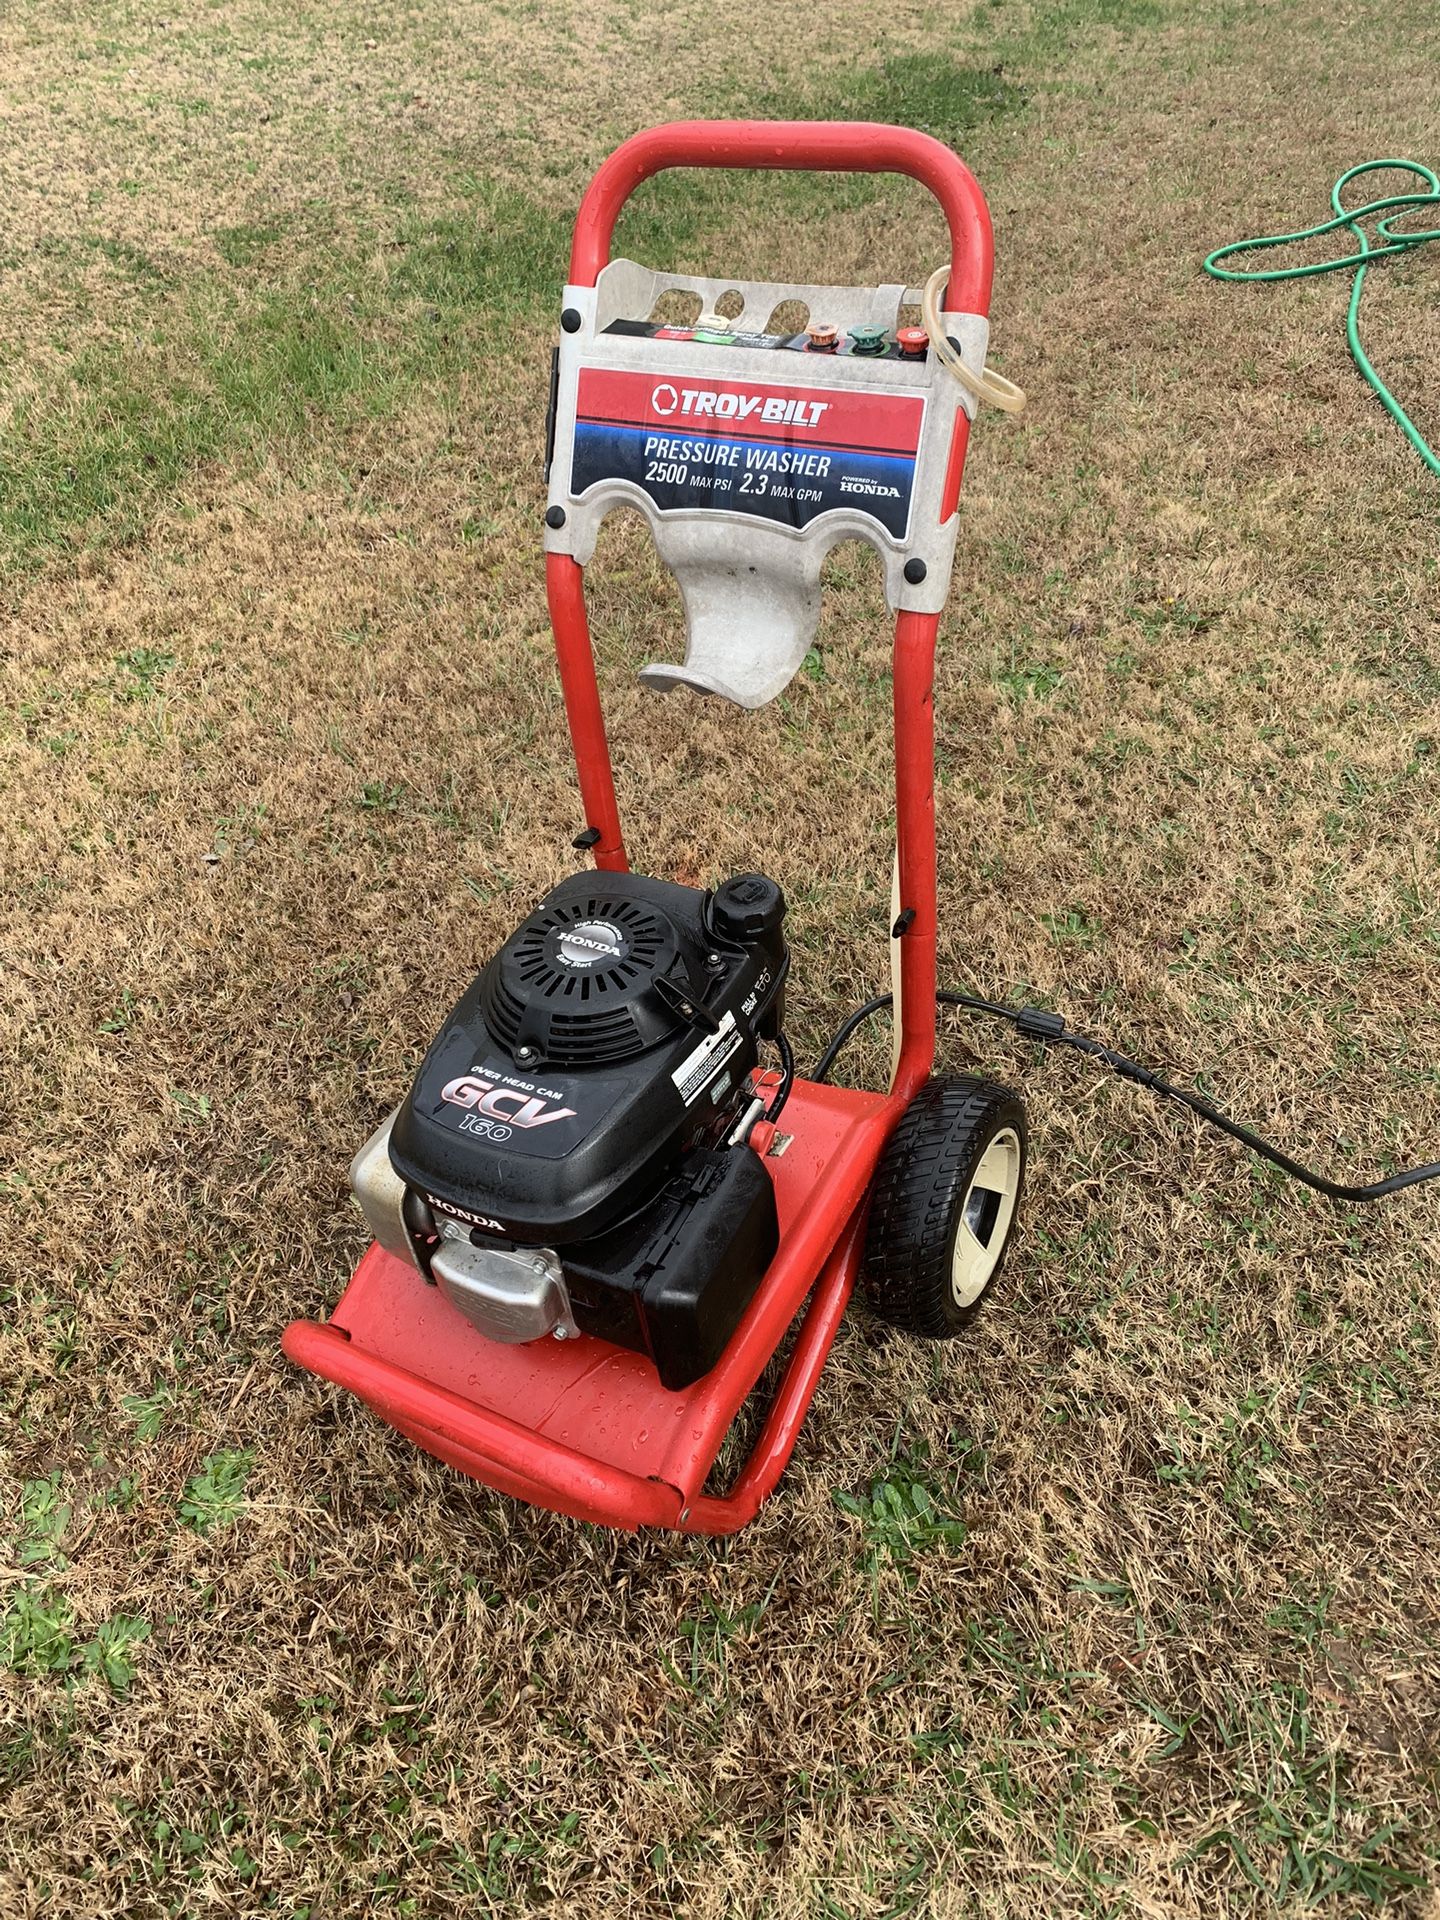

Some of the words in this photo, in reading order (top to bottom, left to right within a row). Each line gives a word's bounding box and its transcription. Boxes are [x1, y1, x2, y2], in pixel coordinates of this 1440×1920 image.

[680, 389, 828, 427] TROY-BILT
[643, 436, 742, 467] PRESSURE
[746, 448, 831, 477] WASHER
[644, 461, 688, 485] 2500
[689, 475, 712, 489] MAX
[713, 479, 733, 491] PSI
[739, 472, 769, 495] 2.3
[770, 485, 795, 499] MAX
[796, 488, 823, 502] GPM
[839, 481, 901, 498] HONDA
[841, 475, 870, 484] POWERED
[556, 932, 621, 957] HONDA
[470, 1065, 502, 1080] OVER
[501, 1076, 535, 1092] HEAD
[536, 1087, 563, 1101] CAM
[441, 1075, 578, 1129] GCV
[458, 1113, 513, 1142] 160
[426, 1192, 507, 1232] HONDA
